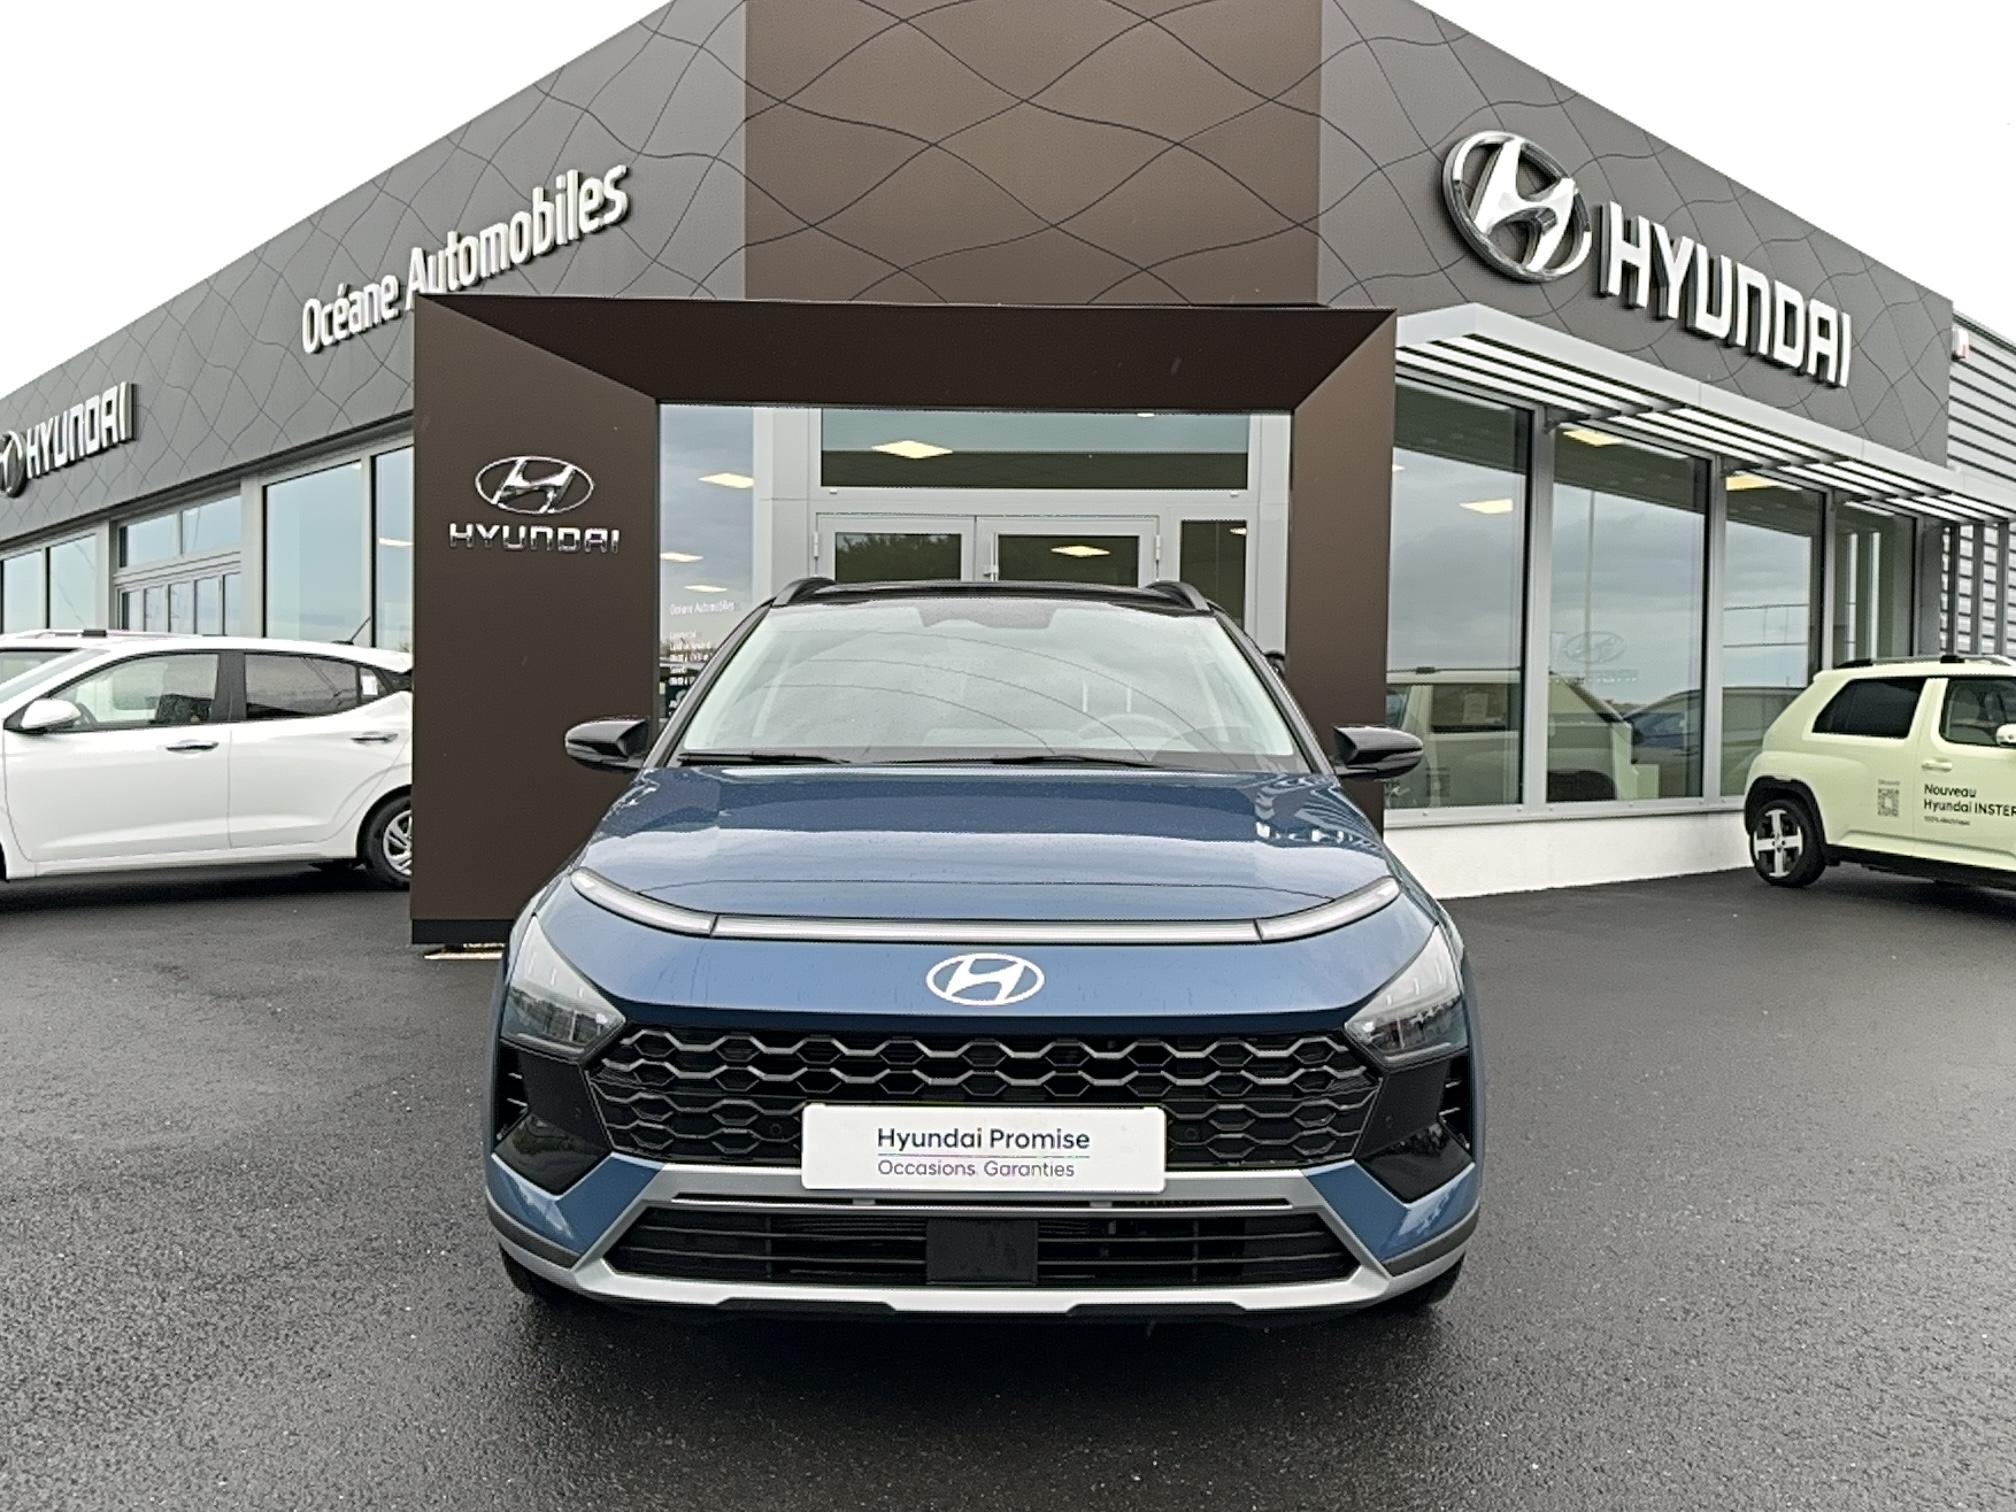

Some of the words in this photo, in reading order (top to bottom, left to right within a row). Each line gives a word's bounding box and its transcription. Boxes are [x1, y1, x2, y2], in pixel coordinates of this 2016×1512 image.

[302, 275, 399, 354] Océane
[405, 164, 629, 311] Automobiles
[1601, 200, 1852, 387] HYUNDAI
[26, 381, 137, 479] HYUNDAI
[449, 522, 620, 553] HYUNDAI
[1923, 783, 1977, 798] Nouveau
[1923, 798, 1972, 813] Hyundai
[877, 1127, 982, 1152] Hyundai
[989, 1128, 1091, 1150] Promise
[877, 1159, 976, 1177] Occasions
[983, 1160, 1075, 1178] Garanties
